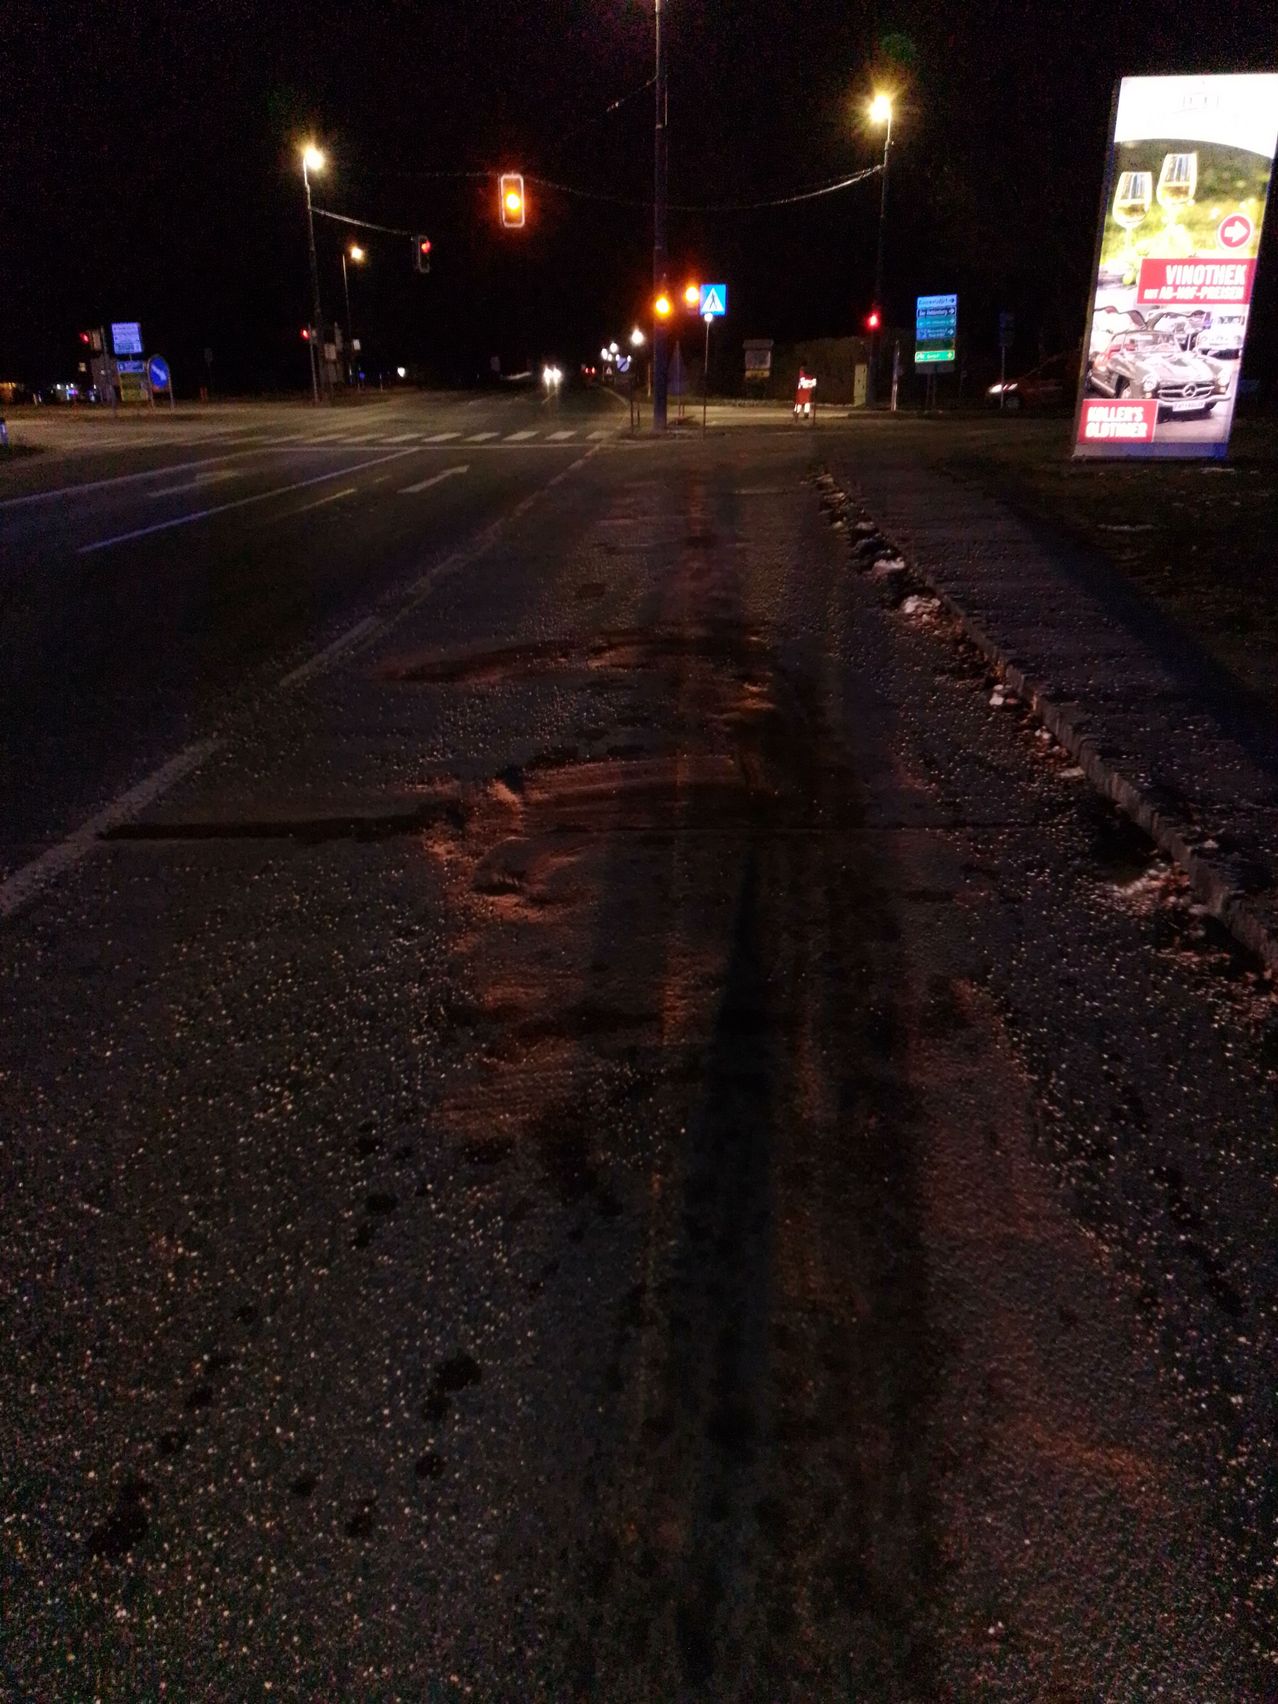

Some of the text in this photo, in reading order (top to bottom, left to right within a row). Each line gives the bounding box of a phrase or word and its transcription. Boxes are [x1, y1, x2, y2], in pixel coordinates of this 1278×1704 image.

[1166, 264, 1247, 285] VINOTHEK
[1087, 406, 1144, 422] KOLLER'S
[1086, 422, 1147, 438] OLDTIMER
